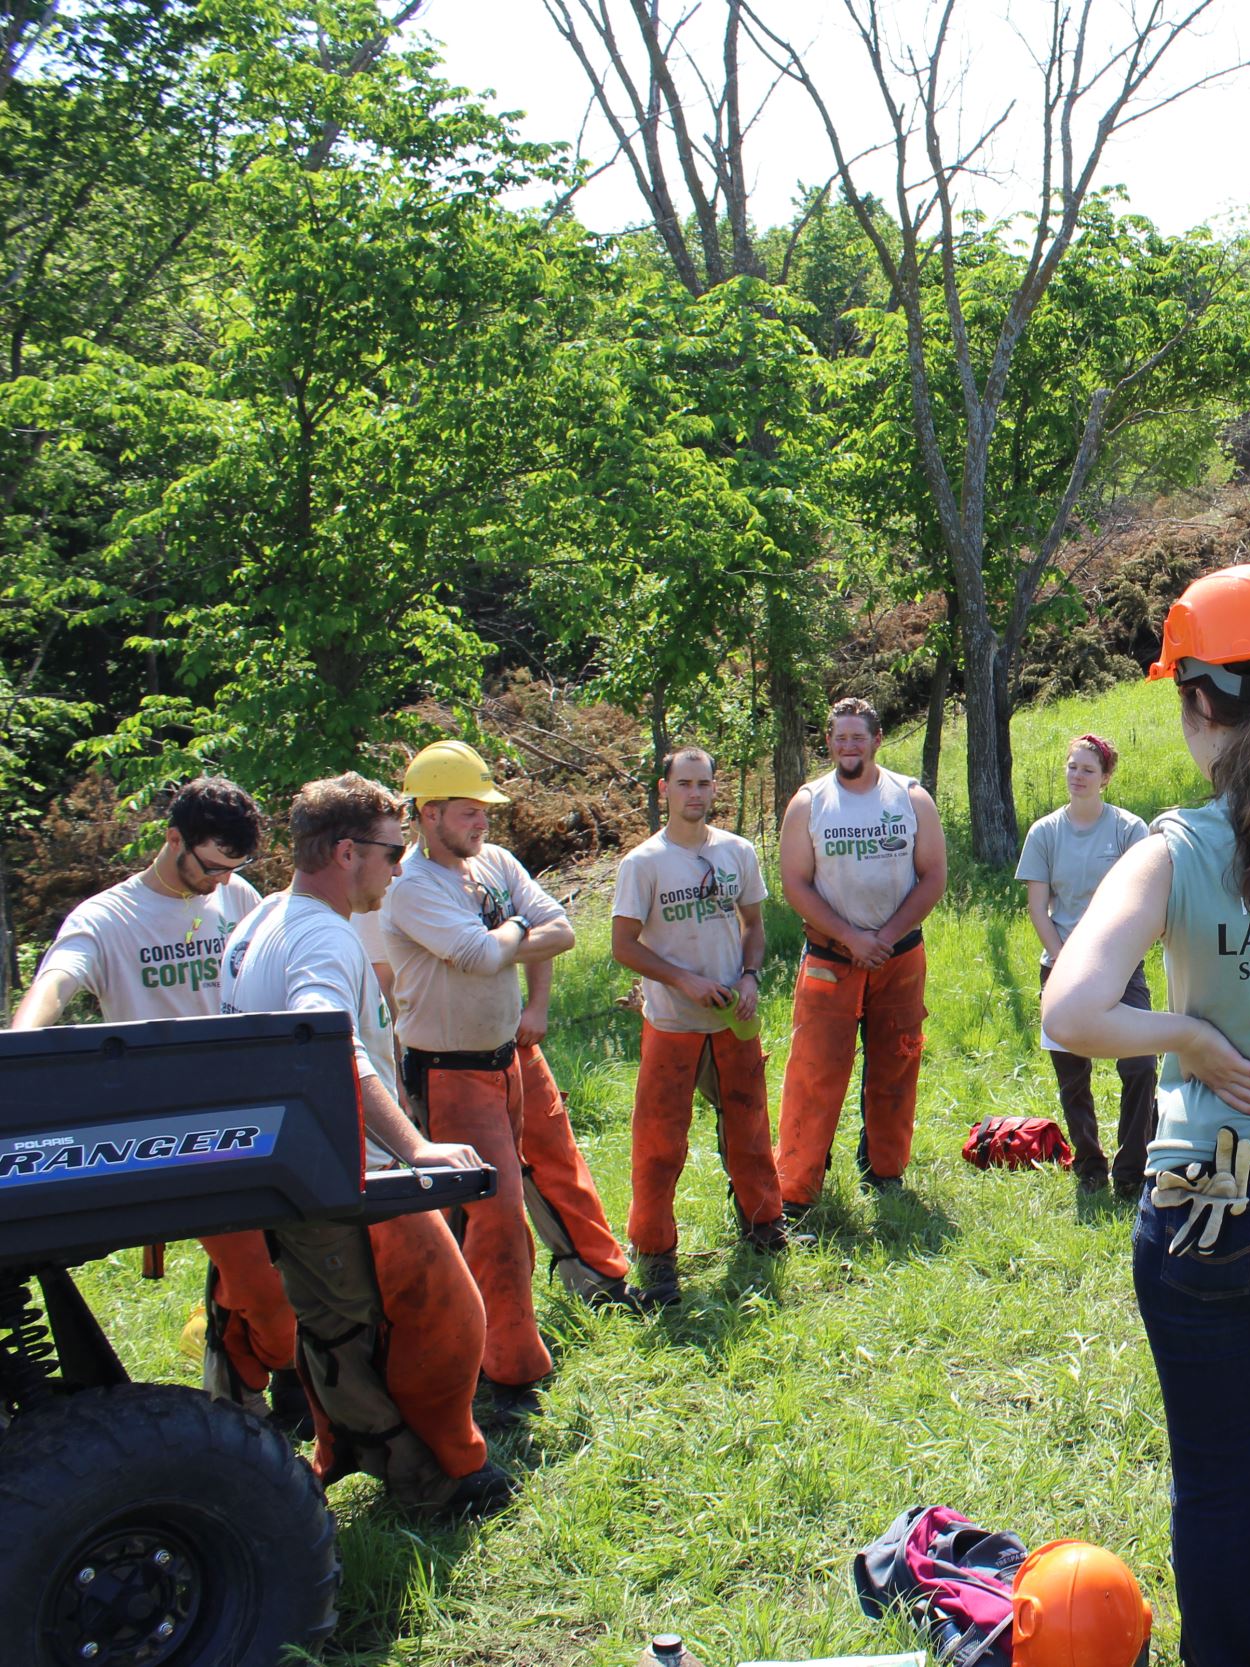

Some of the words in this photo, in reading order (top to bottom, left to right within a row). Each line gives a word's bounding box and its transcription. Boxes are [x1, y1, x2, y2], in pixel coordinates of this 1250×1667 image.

[825, 838, 879, 861] corps
[662, 898, 717, 924] corps
[140, 937, 226, 964] conservat
[141, 957, 219, 991] corps
[0, 1126, 261, 1178] RANGER
[14, 1136, 75, 1150] POLARIS
